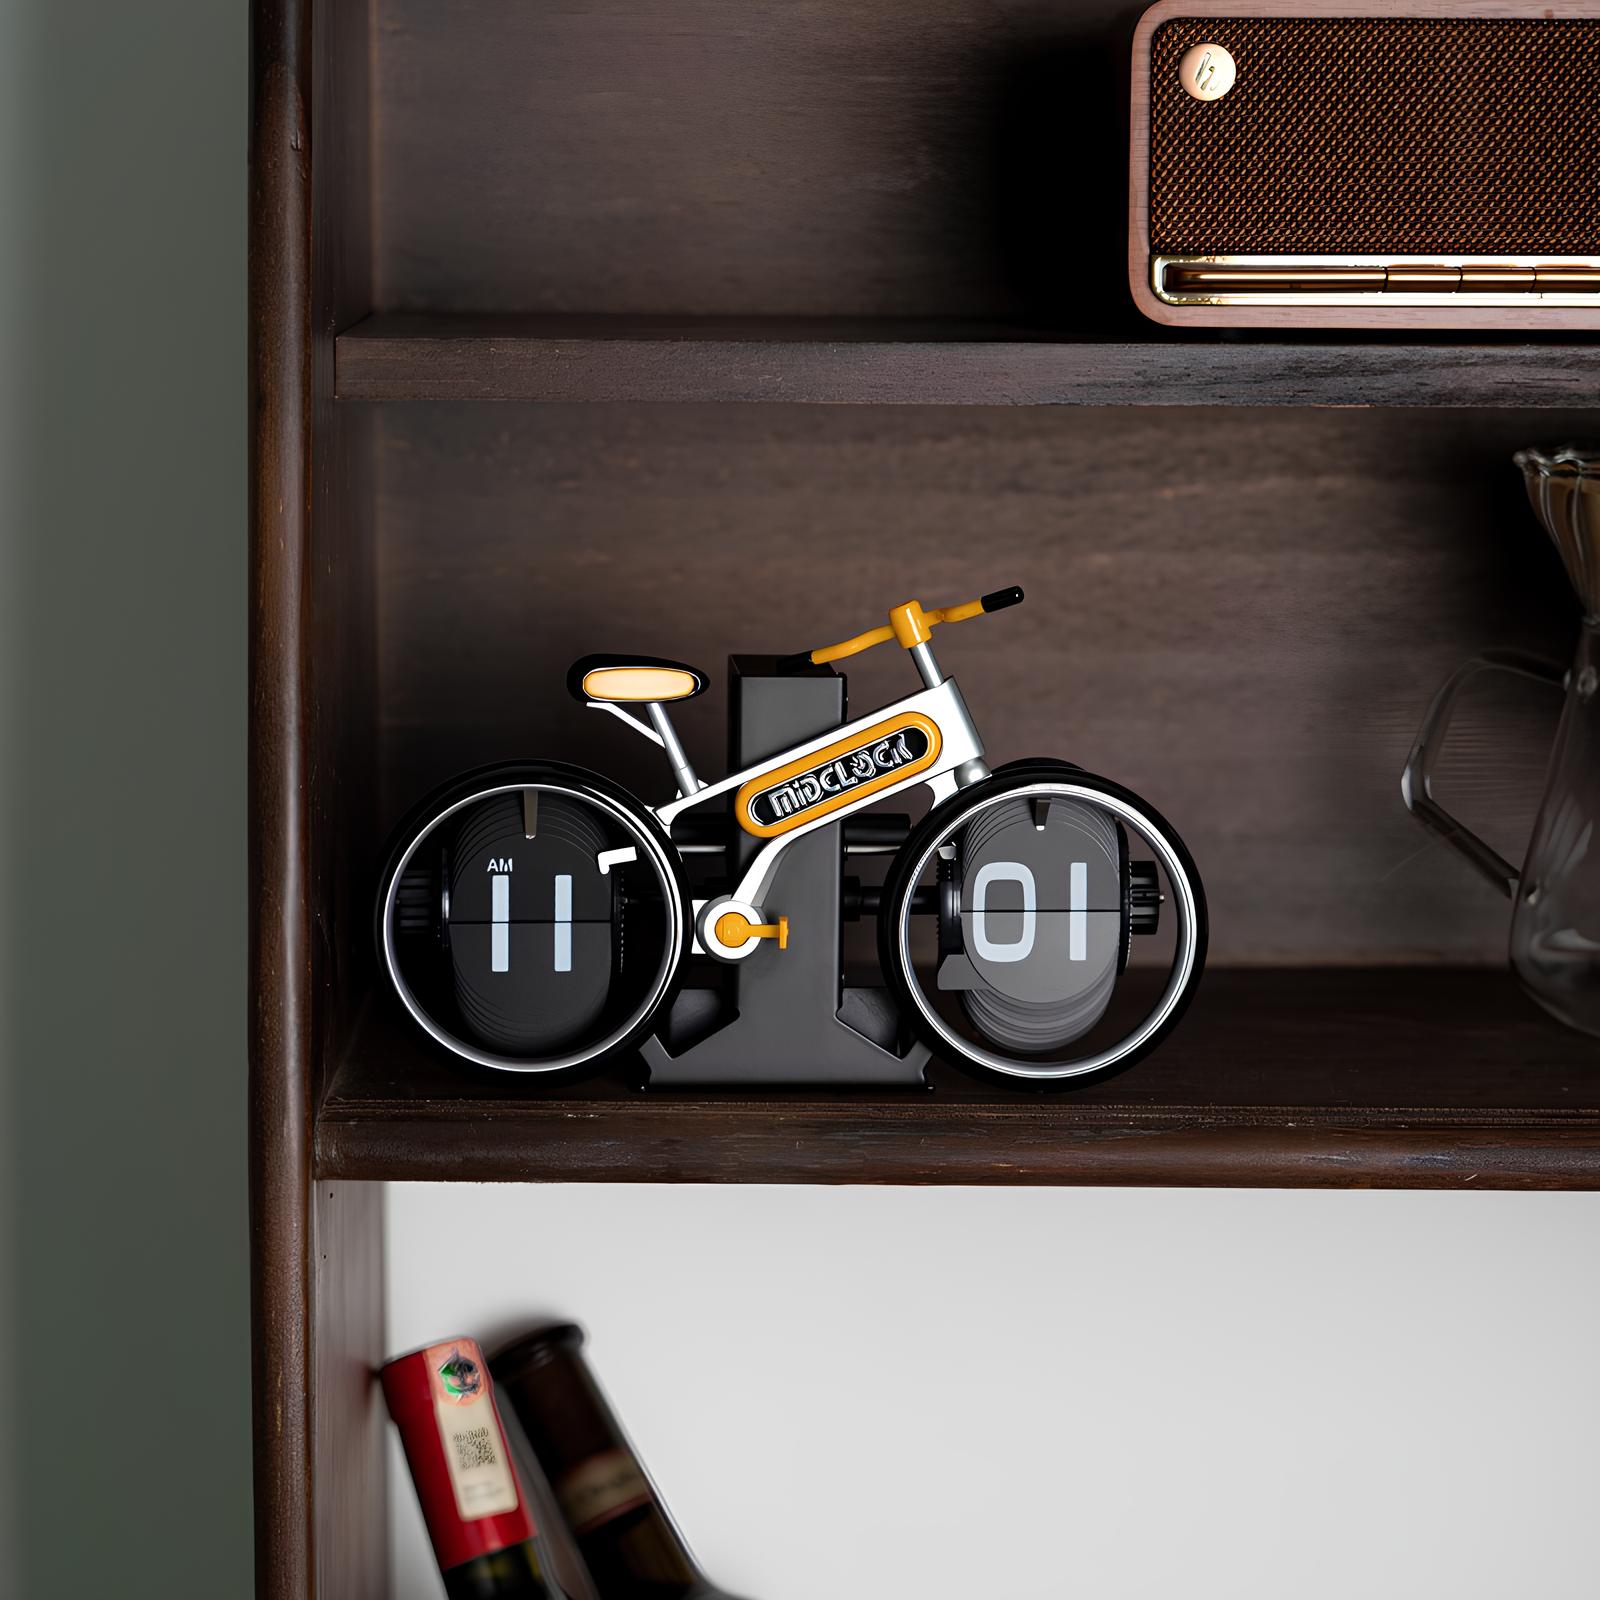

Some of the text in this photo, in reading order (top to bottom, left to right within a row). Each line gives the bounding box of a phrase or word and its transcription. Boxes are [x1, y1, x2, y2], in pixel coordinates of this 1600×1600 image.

[487, 858, 513, 872] AM
[972, 861, 1088, 963] 01
[491, 874, 573, 972] 11
